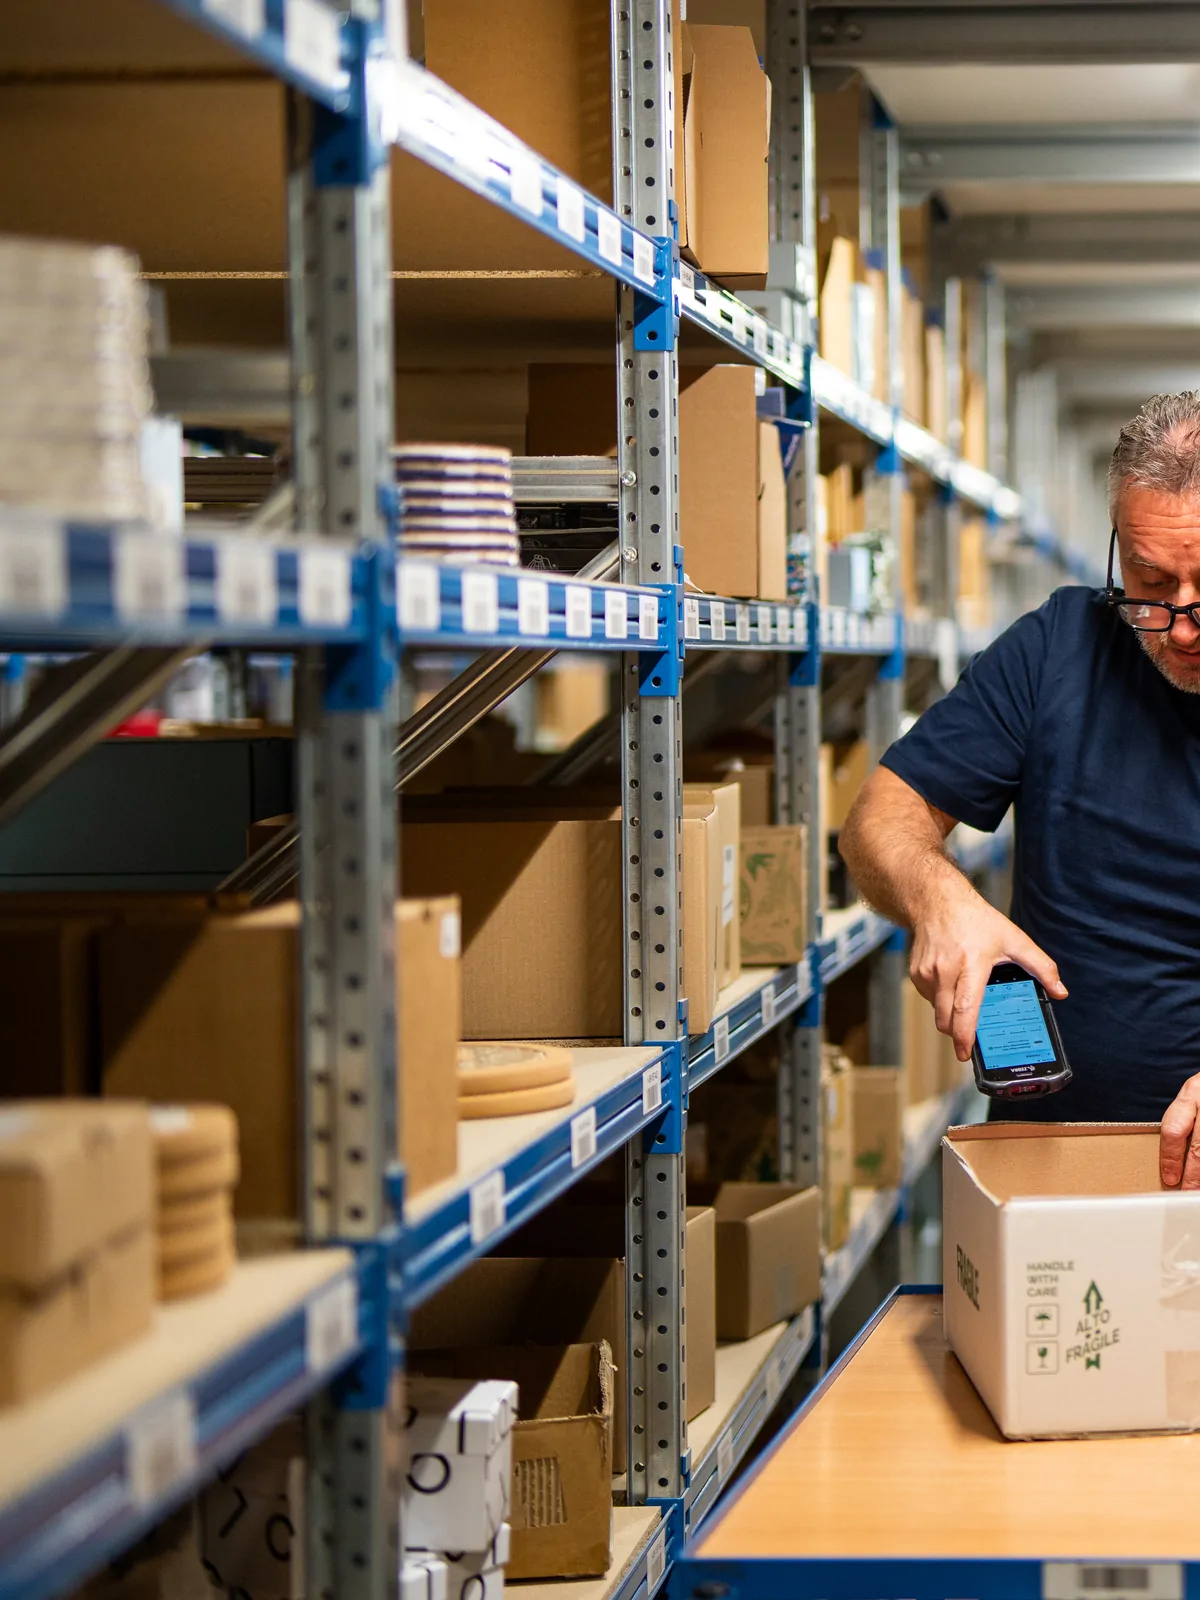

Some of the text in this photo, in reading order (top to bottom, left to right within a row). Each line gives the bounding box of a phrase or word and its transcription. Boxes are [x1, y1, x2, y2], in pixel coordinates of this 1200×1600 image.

[1026, 1261, 1074, 1271] HANDLE
[957, 1244, 980, 1312] FRAGILE
[1027, 1274, 1058, 1284] WITH
[1026, 1287, 1058, 1297] CARE
[1065, 1328, 1120, 1363] FRAGILE
